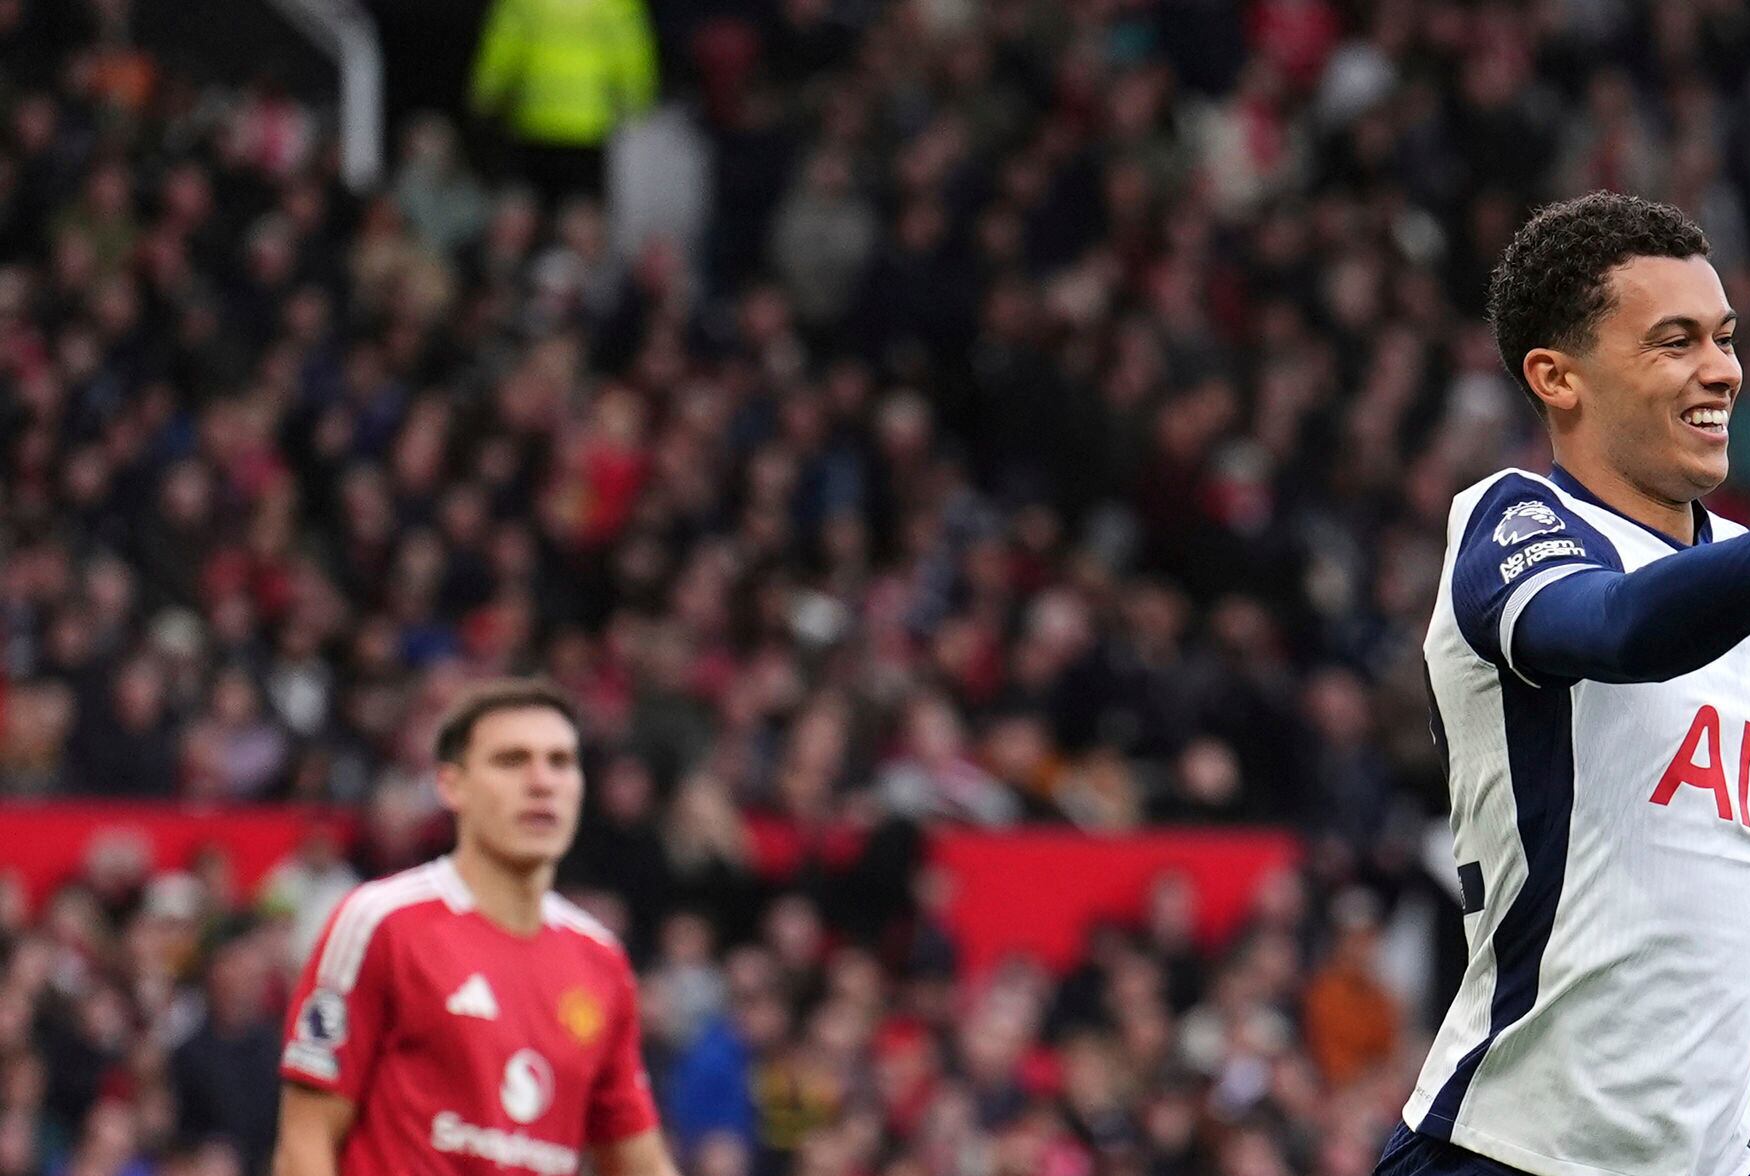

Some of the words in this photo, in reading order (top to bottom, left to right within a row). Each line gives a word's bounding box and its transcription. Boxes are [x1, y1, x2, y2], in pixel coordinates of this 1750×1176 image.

[1500, 553, 1524, 571] No
[1524, 540, 1574, 557] room
[1526, 547, 1586, 566] racism
